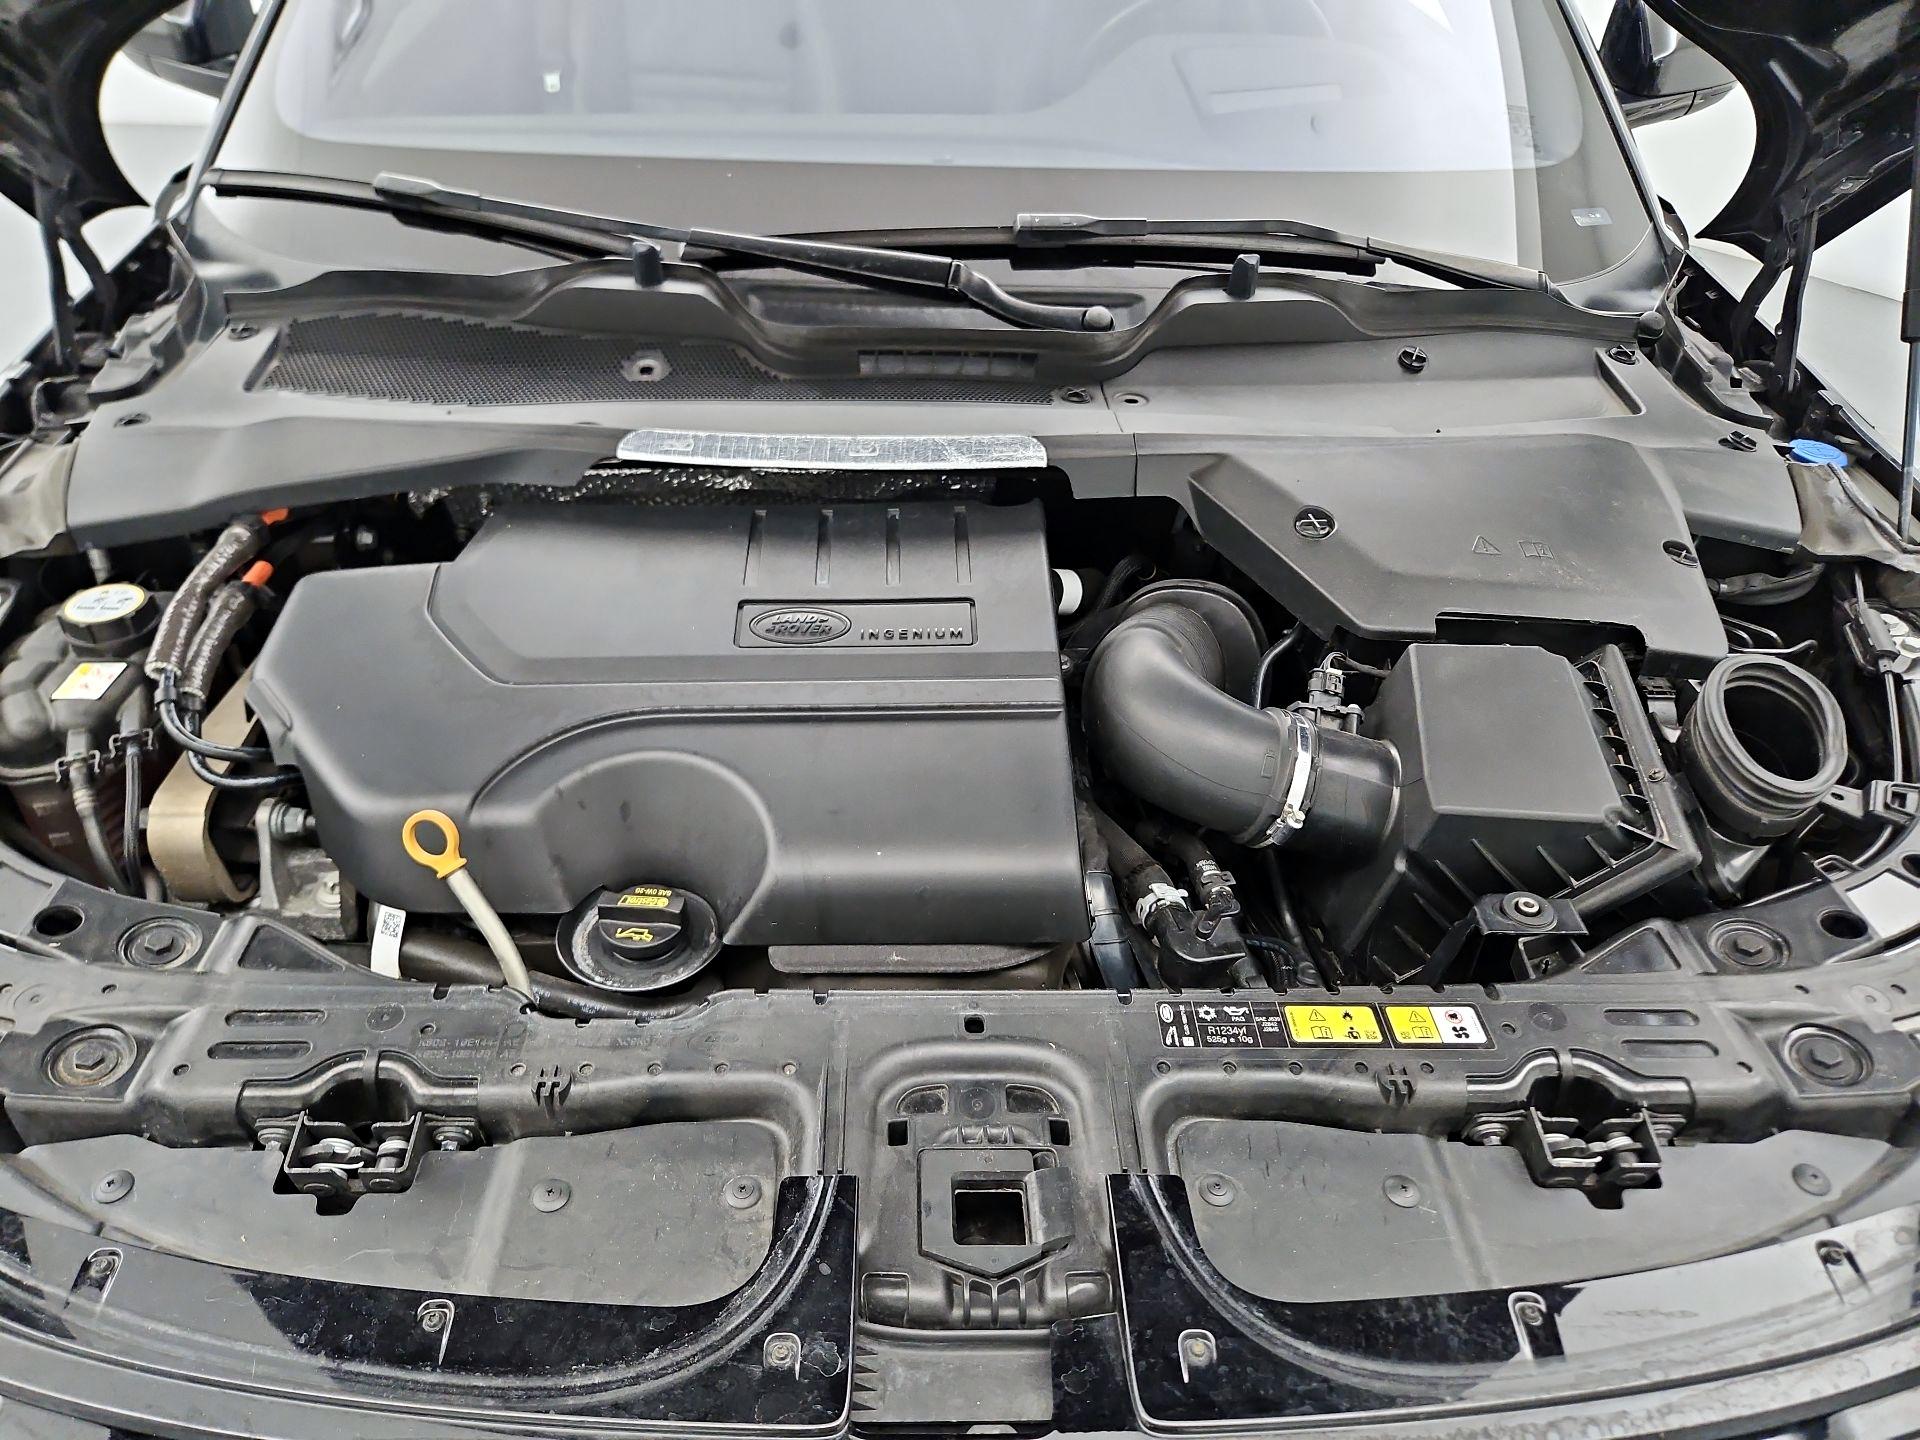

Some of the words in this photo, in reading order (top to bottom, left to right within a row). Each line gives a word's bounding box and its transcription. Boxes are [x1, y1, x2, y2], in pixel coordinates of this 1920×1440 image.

[771, 614, 822, 625] LAND
[772, 624, 833, 636] ROVER
[860, 627, 964, 640] INGENIUM
[1208, 1026, 1247, 1036] R1234yf
[1207, 1036, 1227, 1044] 525g
[1238, 1036, 1253, 1044] 10g
